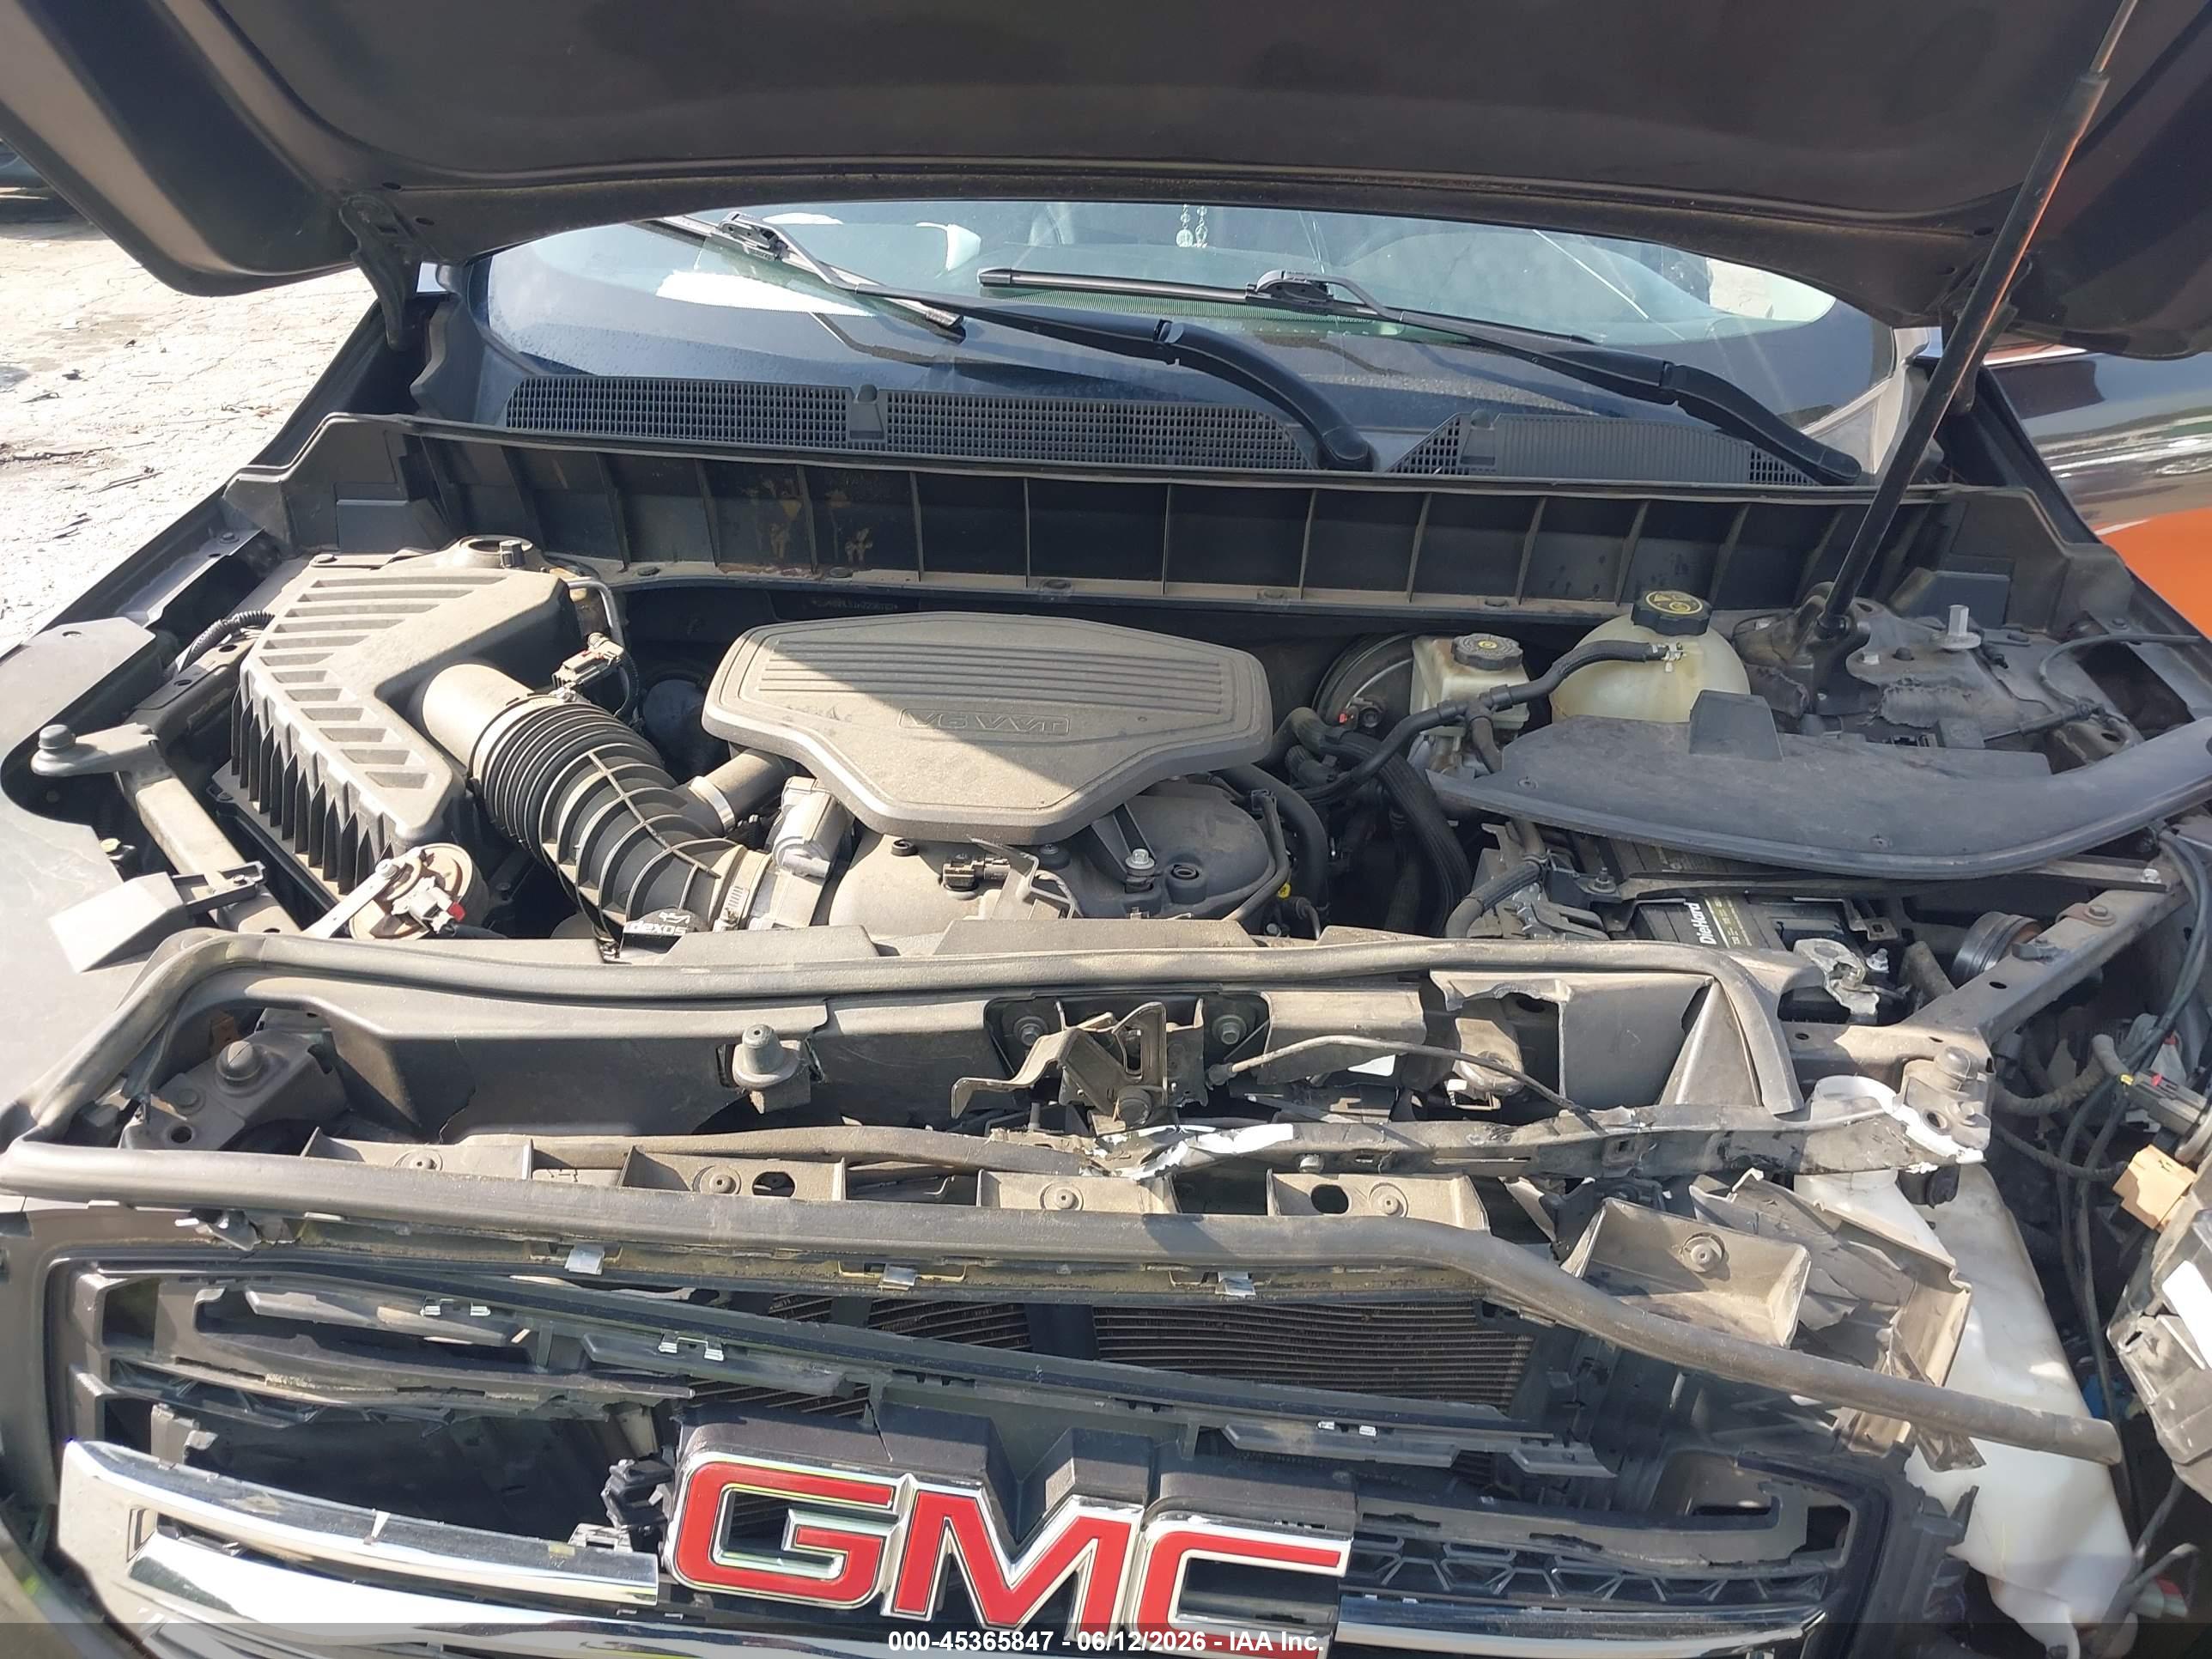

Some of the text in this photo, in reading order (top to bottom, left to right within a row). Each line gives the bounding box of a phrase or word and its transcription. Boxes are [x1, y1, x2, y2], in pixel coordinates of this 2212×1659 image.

[906, 712, 1063, 734] V6 VVT
[629, 920, 688, 937] dexos
[1683, 902, 1717, 945] DieHard
[663, 1451, 1354, 1659] GMC
